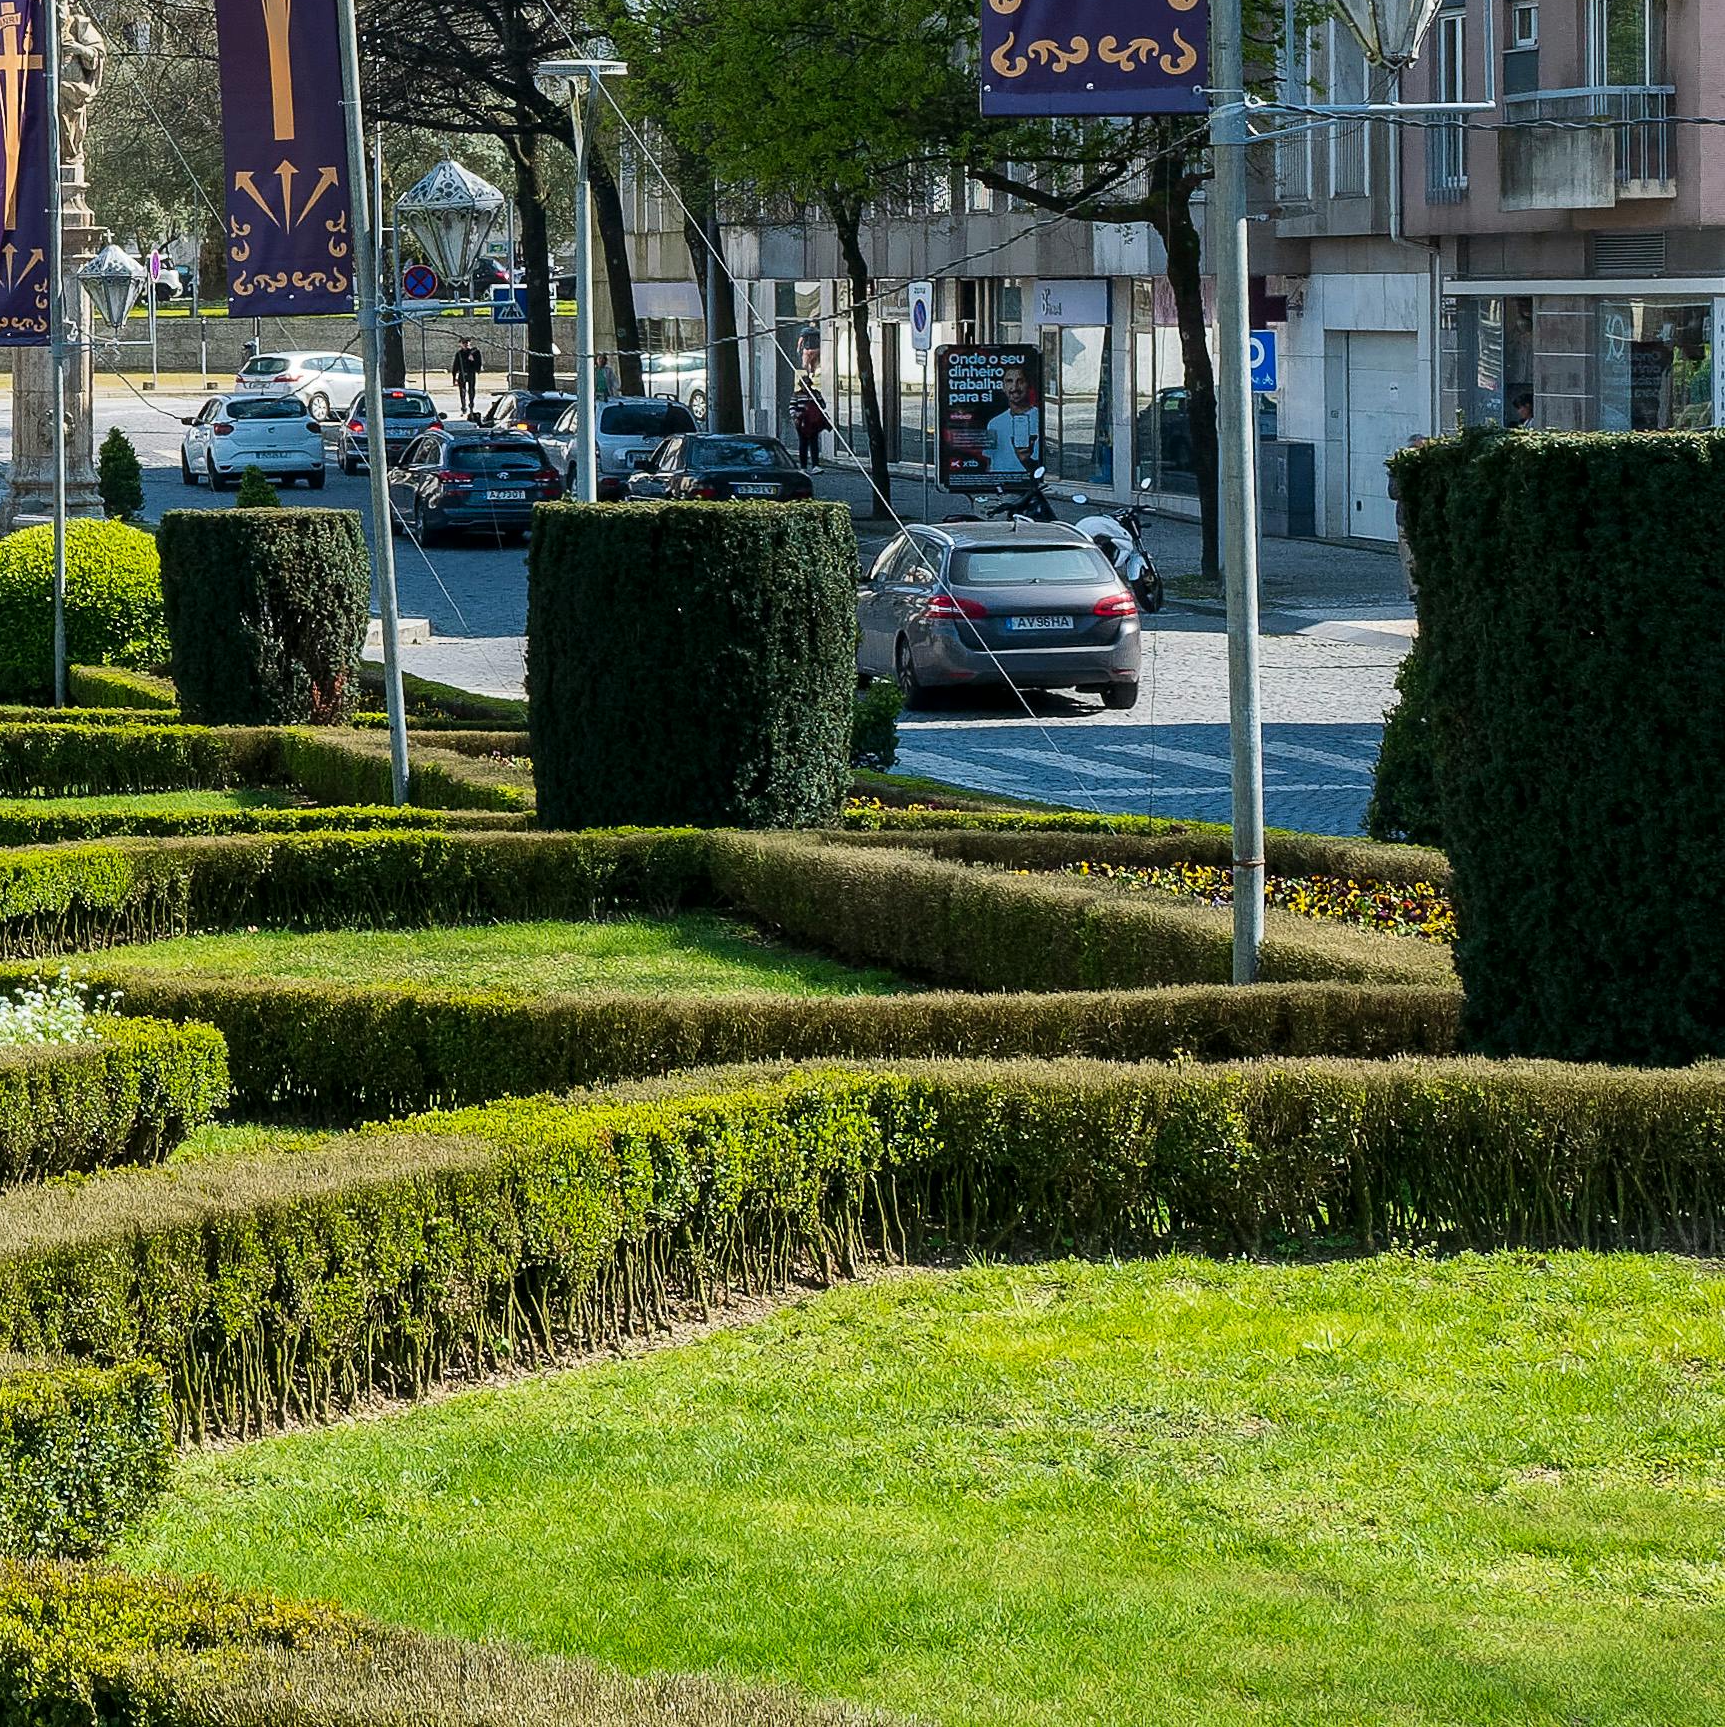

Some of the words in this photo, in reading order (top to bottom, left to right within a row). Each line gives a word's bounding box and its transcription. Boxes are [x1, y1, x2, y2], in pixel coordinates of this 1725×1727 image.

[0, 15, 19, 26] INRI
[949, 353, 987, 365] Onde
[989, 355, 998, 365] o
[1000, 354, 1025, 365] seu
[948, 365, 1004, 377] dinheiro
[948, 378, 1004, 390] trabalha
[949, 393, 979, 406] para
[981, 390, 993, 402] si
[962, 458, 979, 467] xtb
